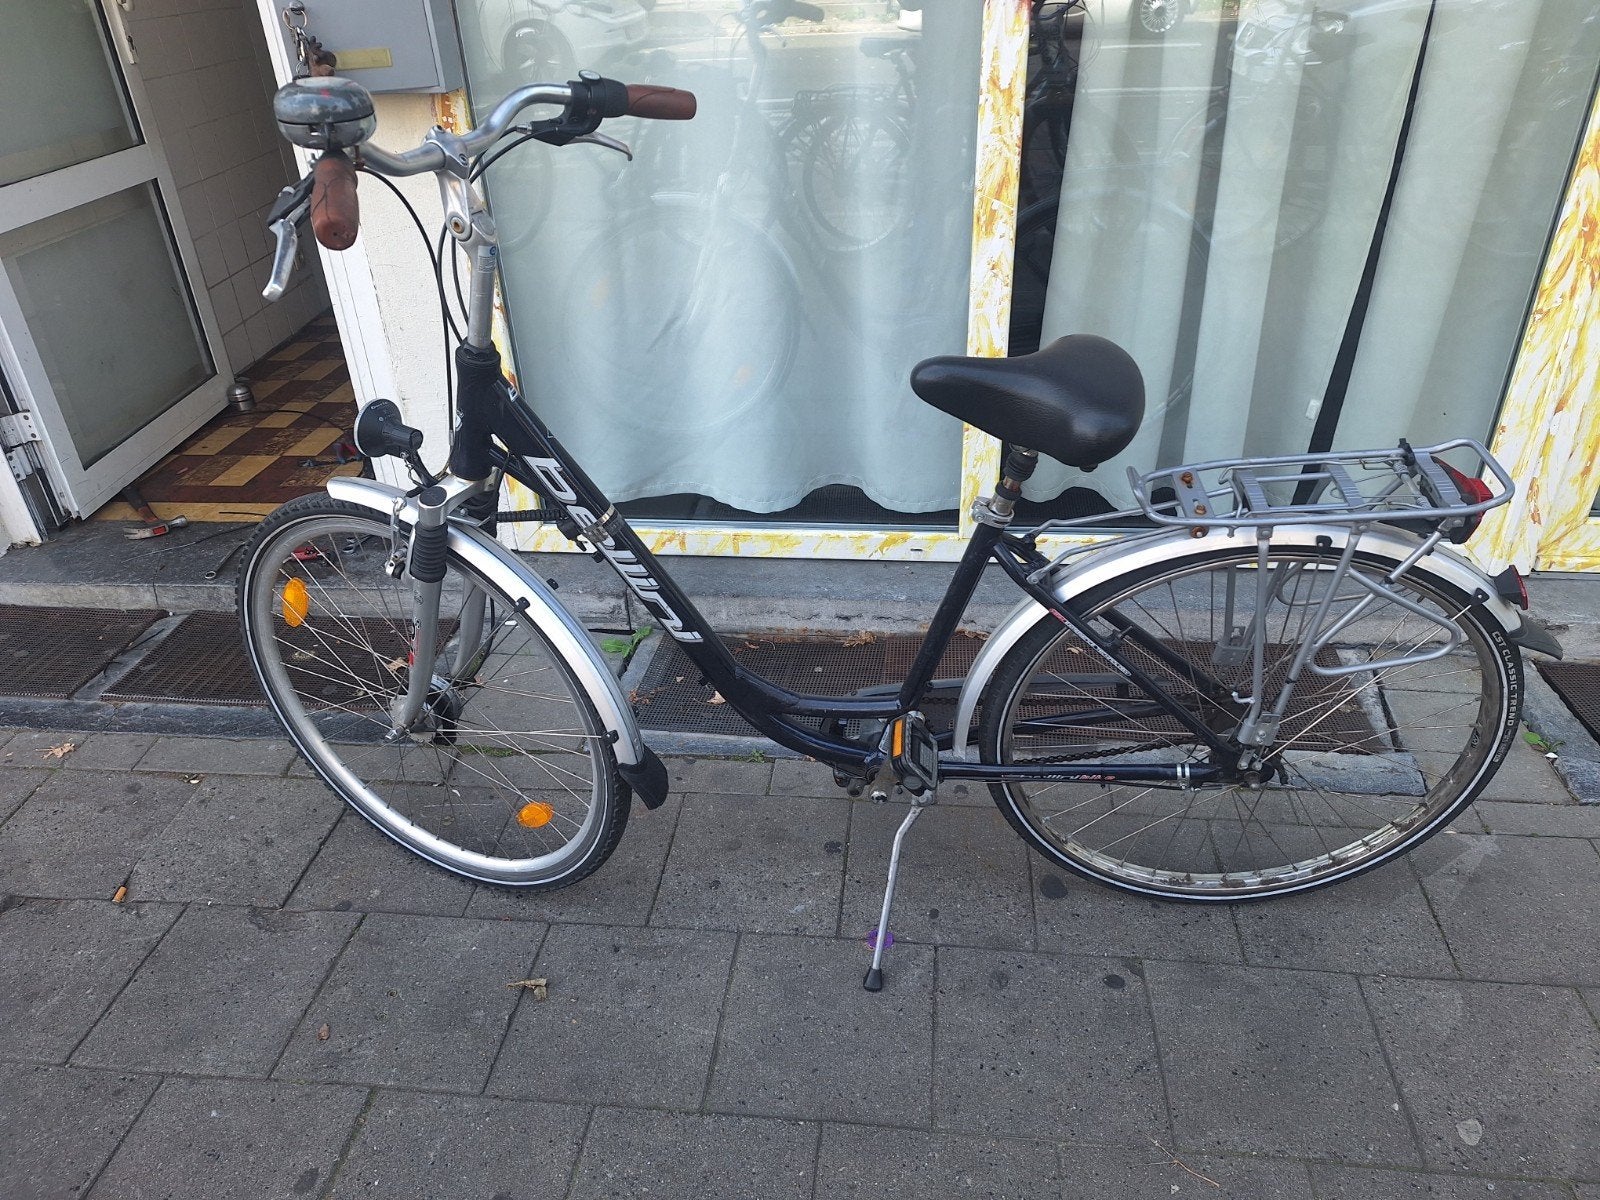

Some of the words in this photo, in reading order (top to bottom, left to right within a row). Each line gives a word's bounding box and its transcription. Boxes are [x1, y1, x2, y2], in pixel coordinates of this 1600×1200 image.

[1492, 631, 1507, 647] CST
[1502, 649, 1518, 691] CLASSIC
[1507, 693, 1518, 727] TREND
